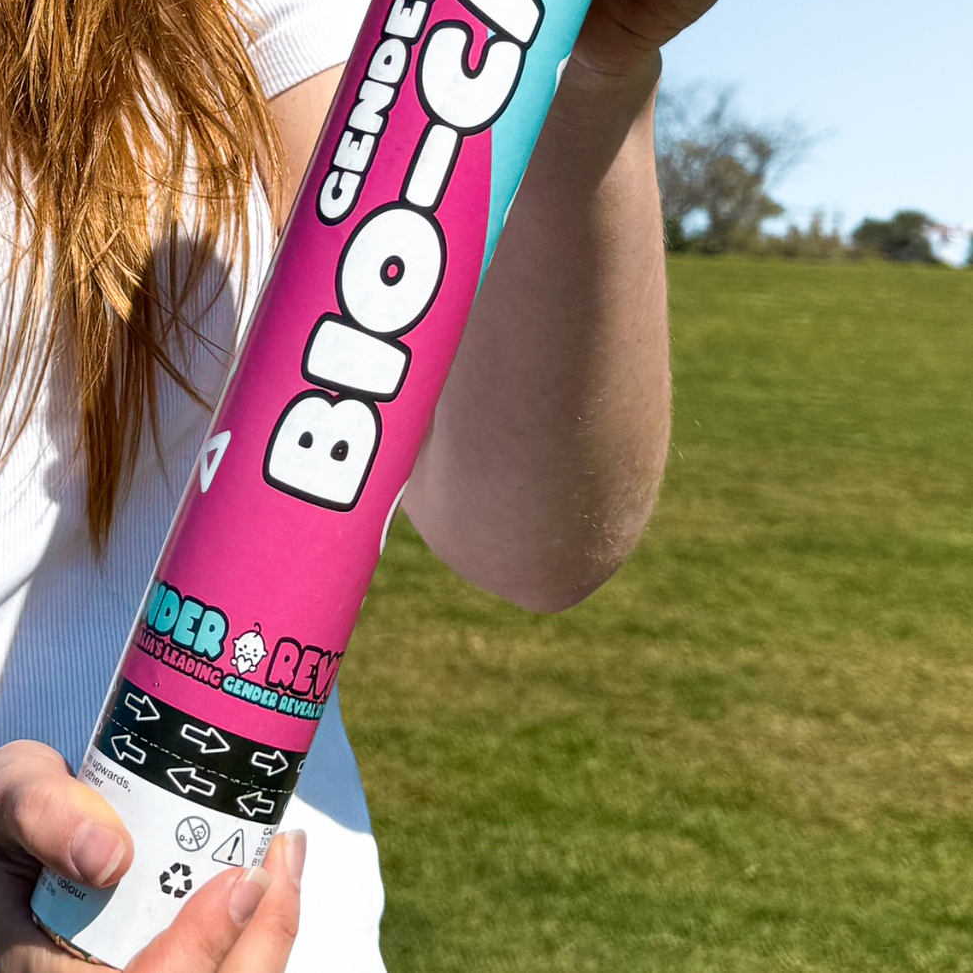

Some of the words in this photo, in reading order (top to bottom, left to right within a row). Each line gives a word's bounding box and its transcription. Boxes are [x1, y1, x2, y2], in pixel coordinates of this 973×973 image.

[162, 646, 222, 688] LEADING
[223, 675, 279, 709] GENDER
[266, 638, 343, 700] REV
[92, 758, 131, 792] upwards,
[57, 876, 87, 901] colour
